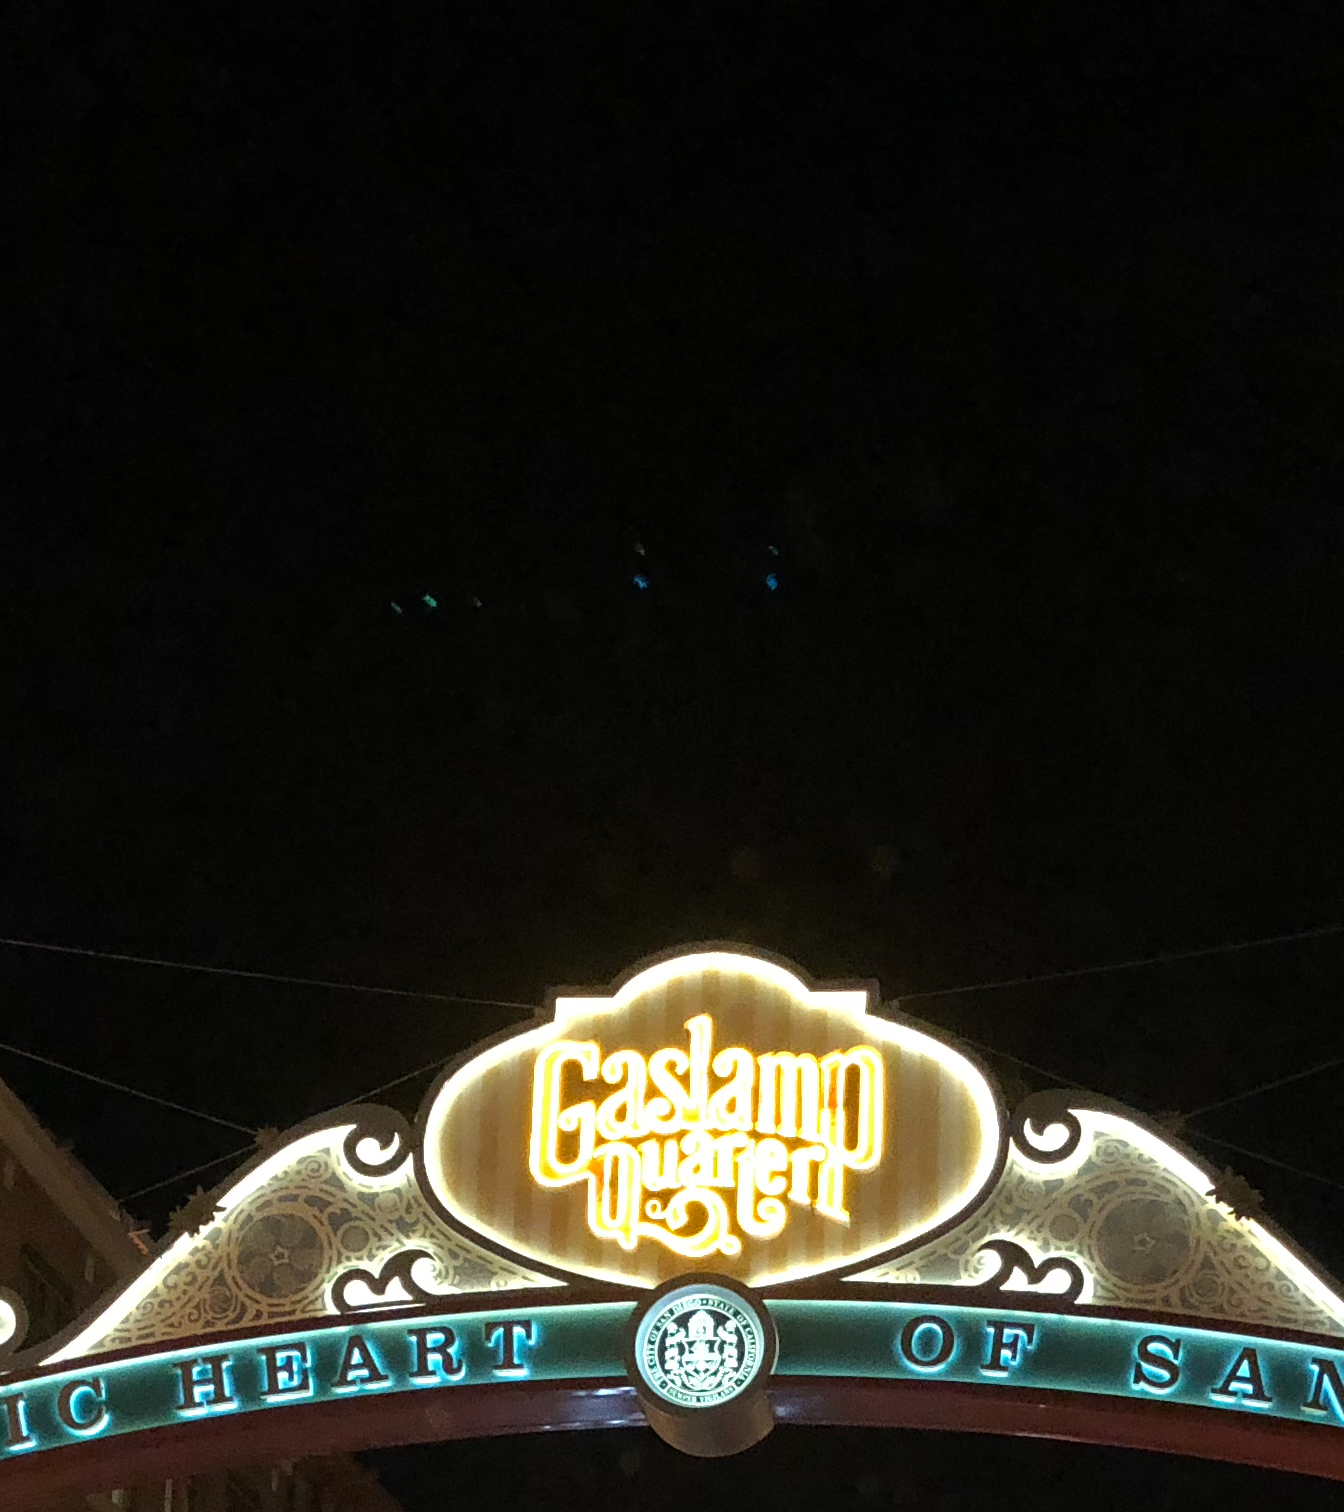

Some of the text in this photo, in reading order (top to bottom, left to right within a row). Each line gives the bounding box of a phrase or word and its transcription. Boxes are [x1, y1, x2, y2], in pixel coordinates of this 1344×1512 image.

[528, 1012, 884, 1224] Gaslamp
[586, 1132, 831, 1258] Quarter
[172, 1319, 540, 1416] HEART
[898, 1313, 1036, 1378] OF
